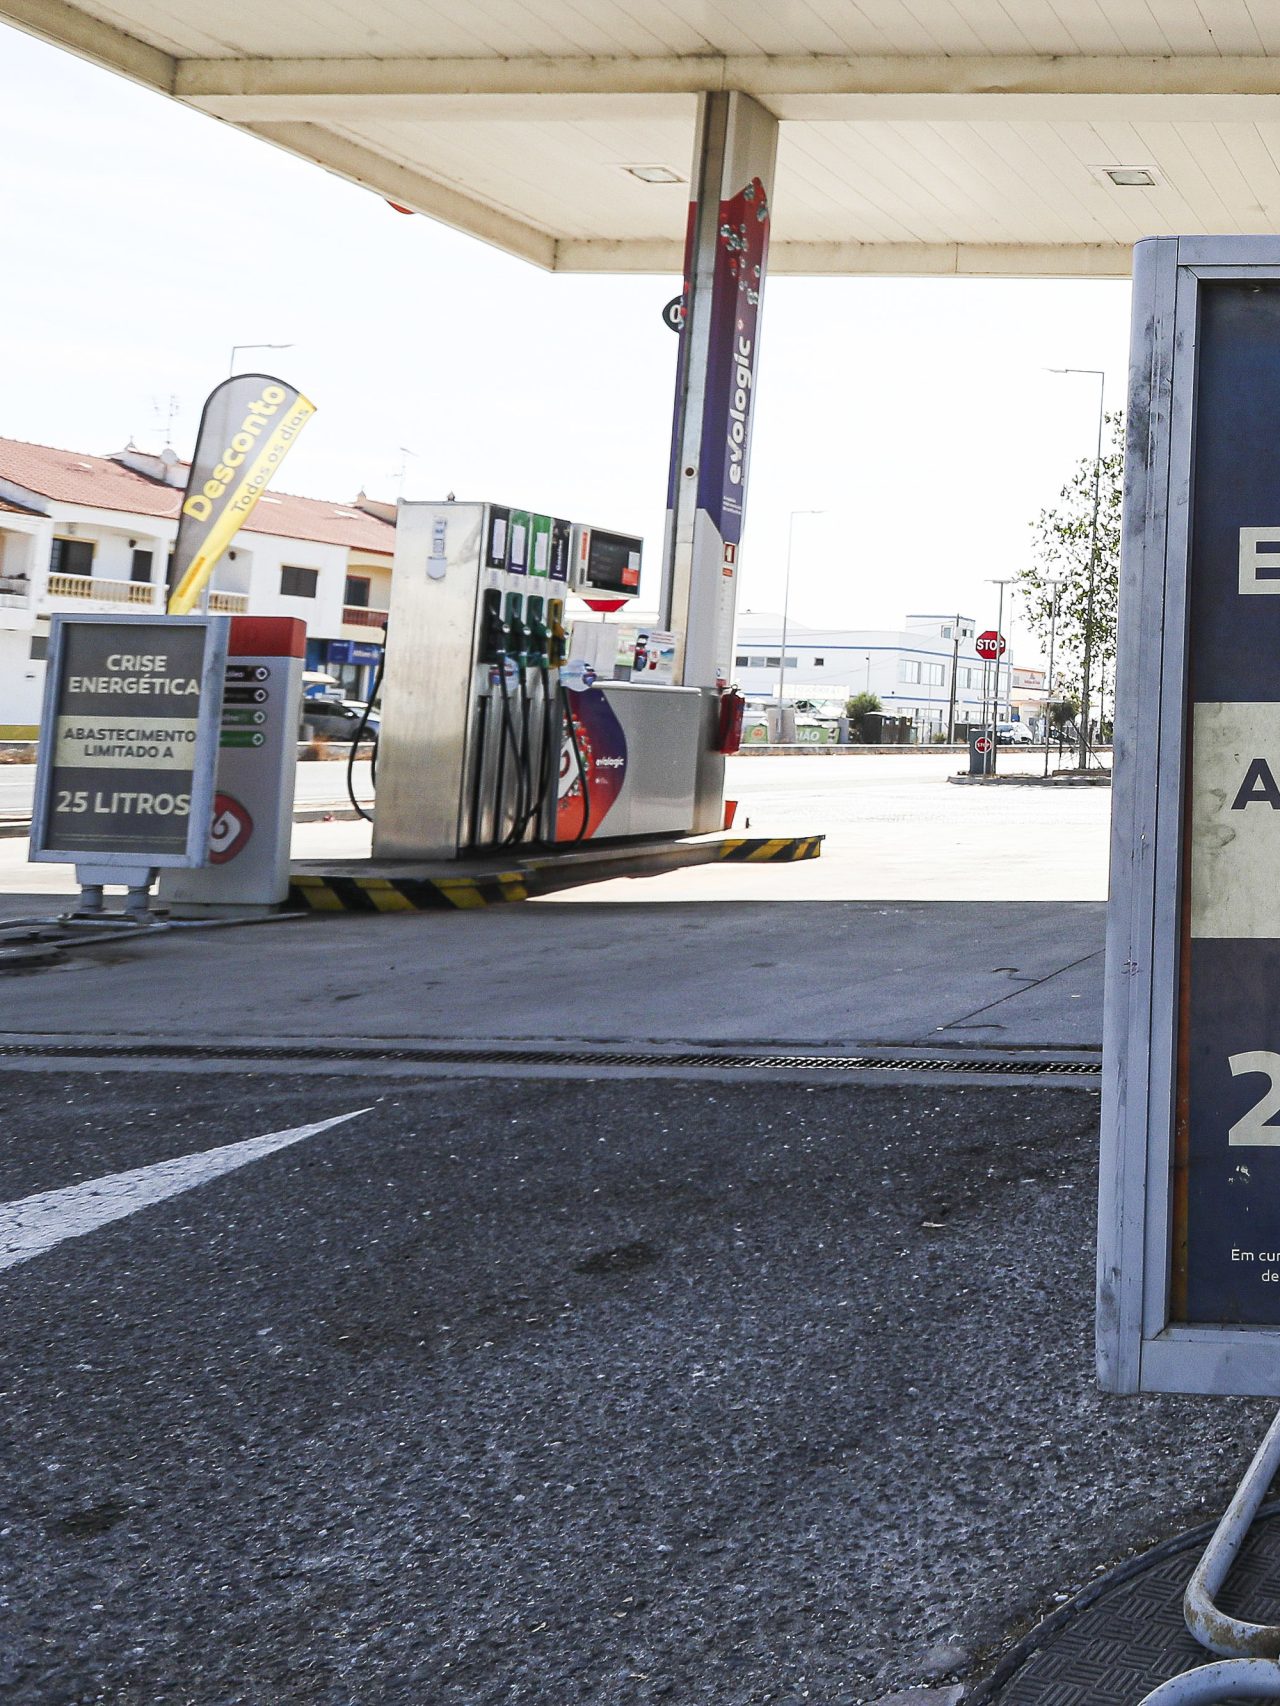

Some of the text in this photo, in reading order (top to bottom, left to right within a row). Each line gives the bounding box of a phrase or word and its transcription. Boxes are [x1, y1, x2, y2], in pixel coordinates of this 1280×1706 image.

[726, 336, 751, 486] evologic
[183, 385, 286, 522] Desconto
[231, 409, 309, 512] Todos os dias
[976, 638, 1005, 650] STOP
[106, 654, 168, 672] CRISE
[68, 675, 200, 695] ENERGÉTICA
[63, 728, 196, 742] ABASTECIMENTO
[84, 745, 174, 758] LIMITADO A
[56, 791, 191, 815] 25 LITROS
[1231, 1249, 1254, 1261] Em
[1261, 1269, 1279, 1282] de
